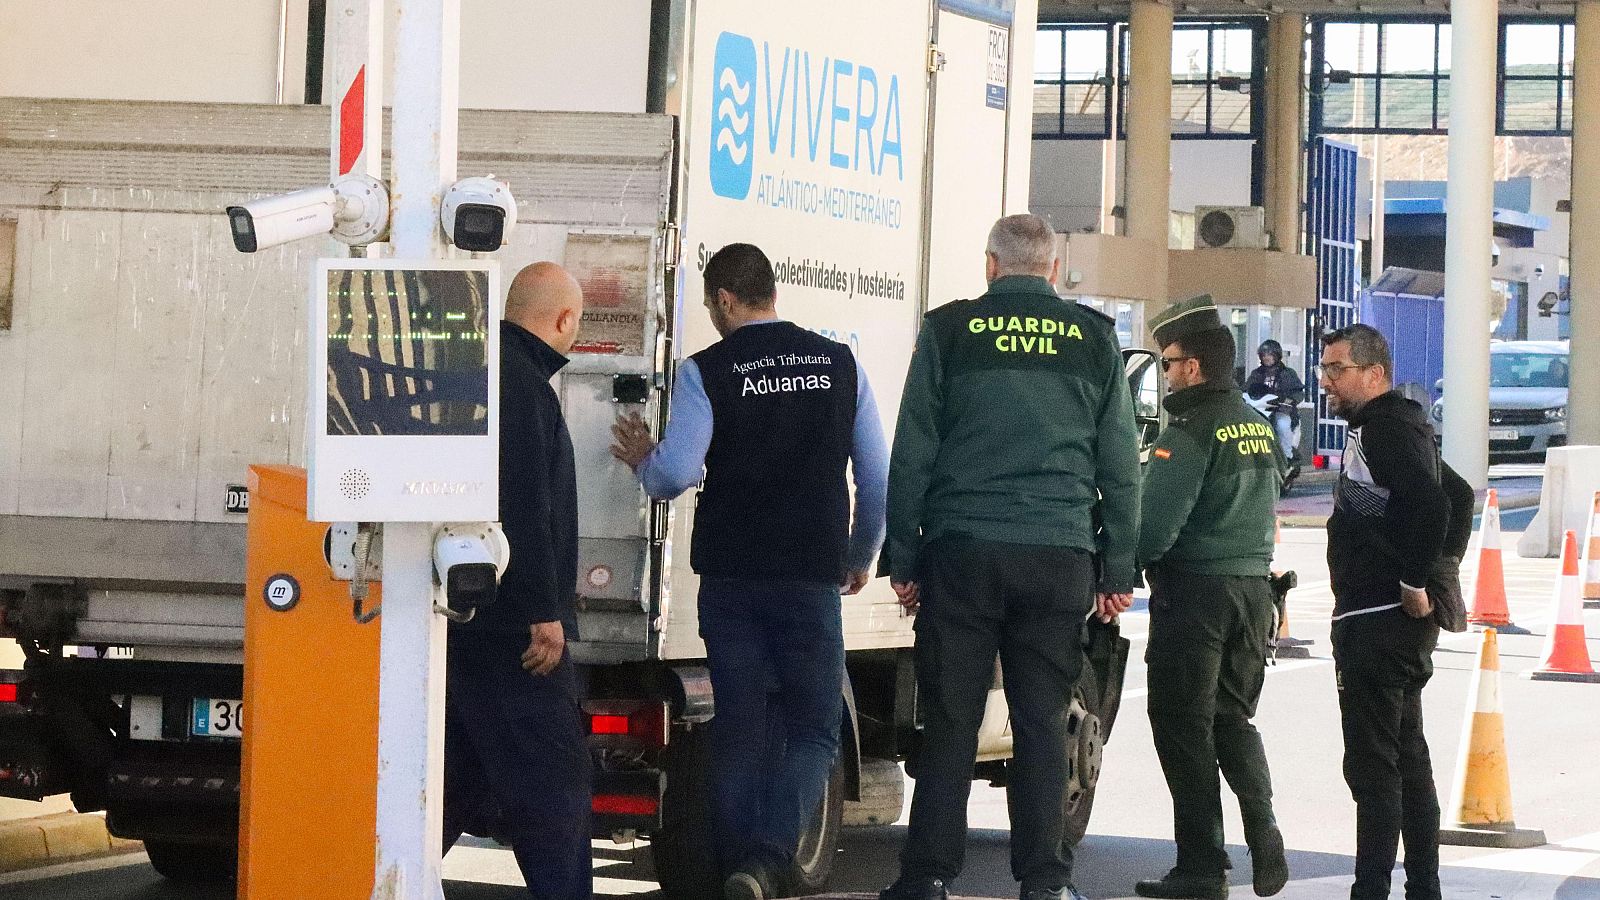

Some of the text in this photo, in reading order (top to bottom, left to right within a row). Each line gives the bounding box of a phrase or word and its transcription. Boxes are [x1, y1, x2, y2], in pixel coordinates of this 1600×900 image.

[988, 29, 1007, 60] FRCX
[764, 41, 903, 181] VIVERA
[757, 170, 902, 230] ATLÁNTICO-MEDITERRÁNEO
[775, 257, 905, 301] colectividades y hostelería
[968, 316, 1083, 340] GUARDIA
[995, 335, 1057, 354] CIVIL
[732, 353, 832, 375] Agencia Tributaria
[741, 374, 832, 397] Aduanas
[1216, 422, 1275, 442] GUARDIA
[1238, 440, 1271, 455] CIVIL
[198, 718, 205, 728] E
